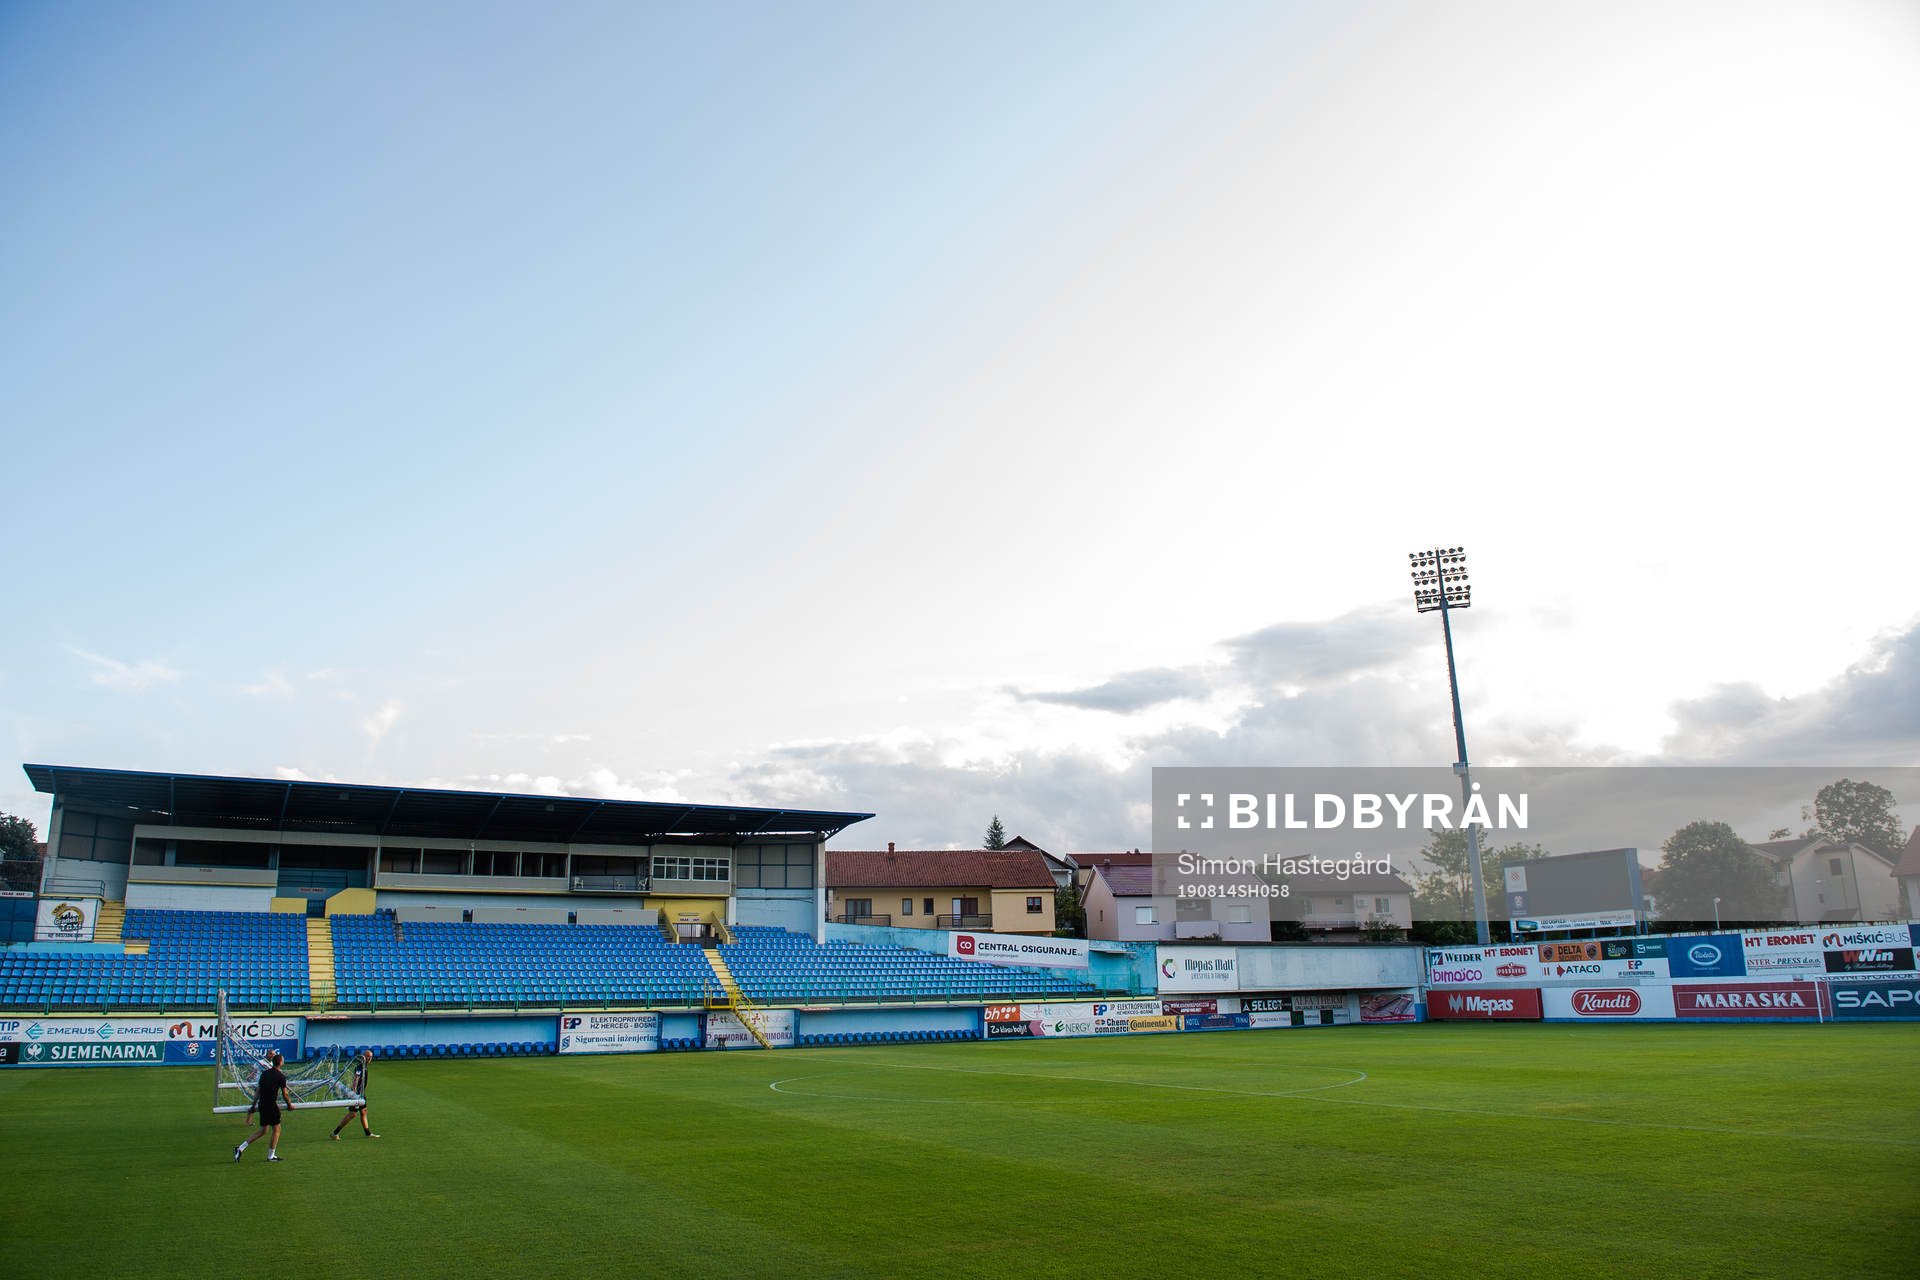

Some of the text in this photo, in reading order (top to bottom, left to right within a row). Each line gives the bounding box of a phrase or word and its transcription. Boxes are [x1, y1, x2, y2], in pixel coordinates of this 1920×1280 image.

[1767, 934, 1815, 946] ERONET
[978, 943, 1020, 952] CENTRAL
[1021, 945, 1078, 956] OSIGURANJE
[1500, 946, 1535, 957] ERONET
[1558, 945, 1582, 955] DELTA
[1185, 959, 1234, 972] Mepas Mall
[1777, 957, 1801, 965] PRESS
[1565, 965, 1601, 974] ATACO
[1580, 994, 1631, 1011] Kandit
[1695, 992, 1806, 1008] MARASKA
[1835, 990, 1920, 1008] SAP
[1252, 1000, 1283, 1011] SELECT
[1466, 996, 1514, 1016] Mepas
[117, 1027, 164, 1035] EMERUS
[1055, 1021, 1091, 1032] ENERGY
[1130, 1019, 1167, 1031] Continental
[575, 1034, 616, 1044] Sigurnosni
[50, 1044, 158, 1060] SJEMENARNA
